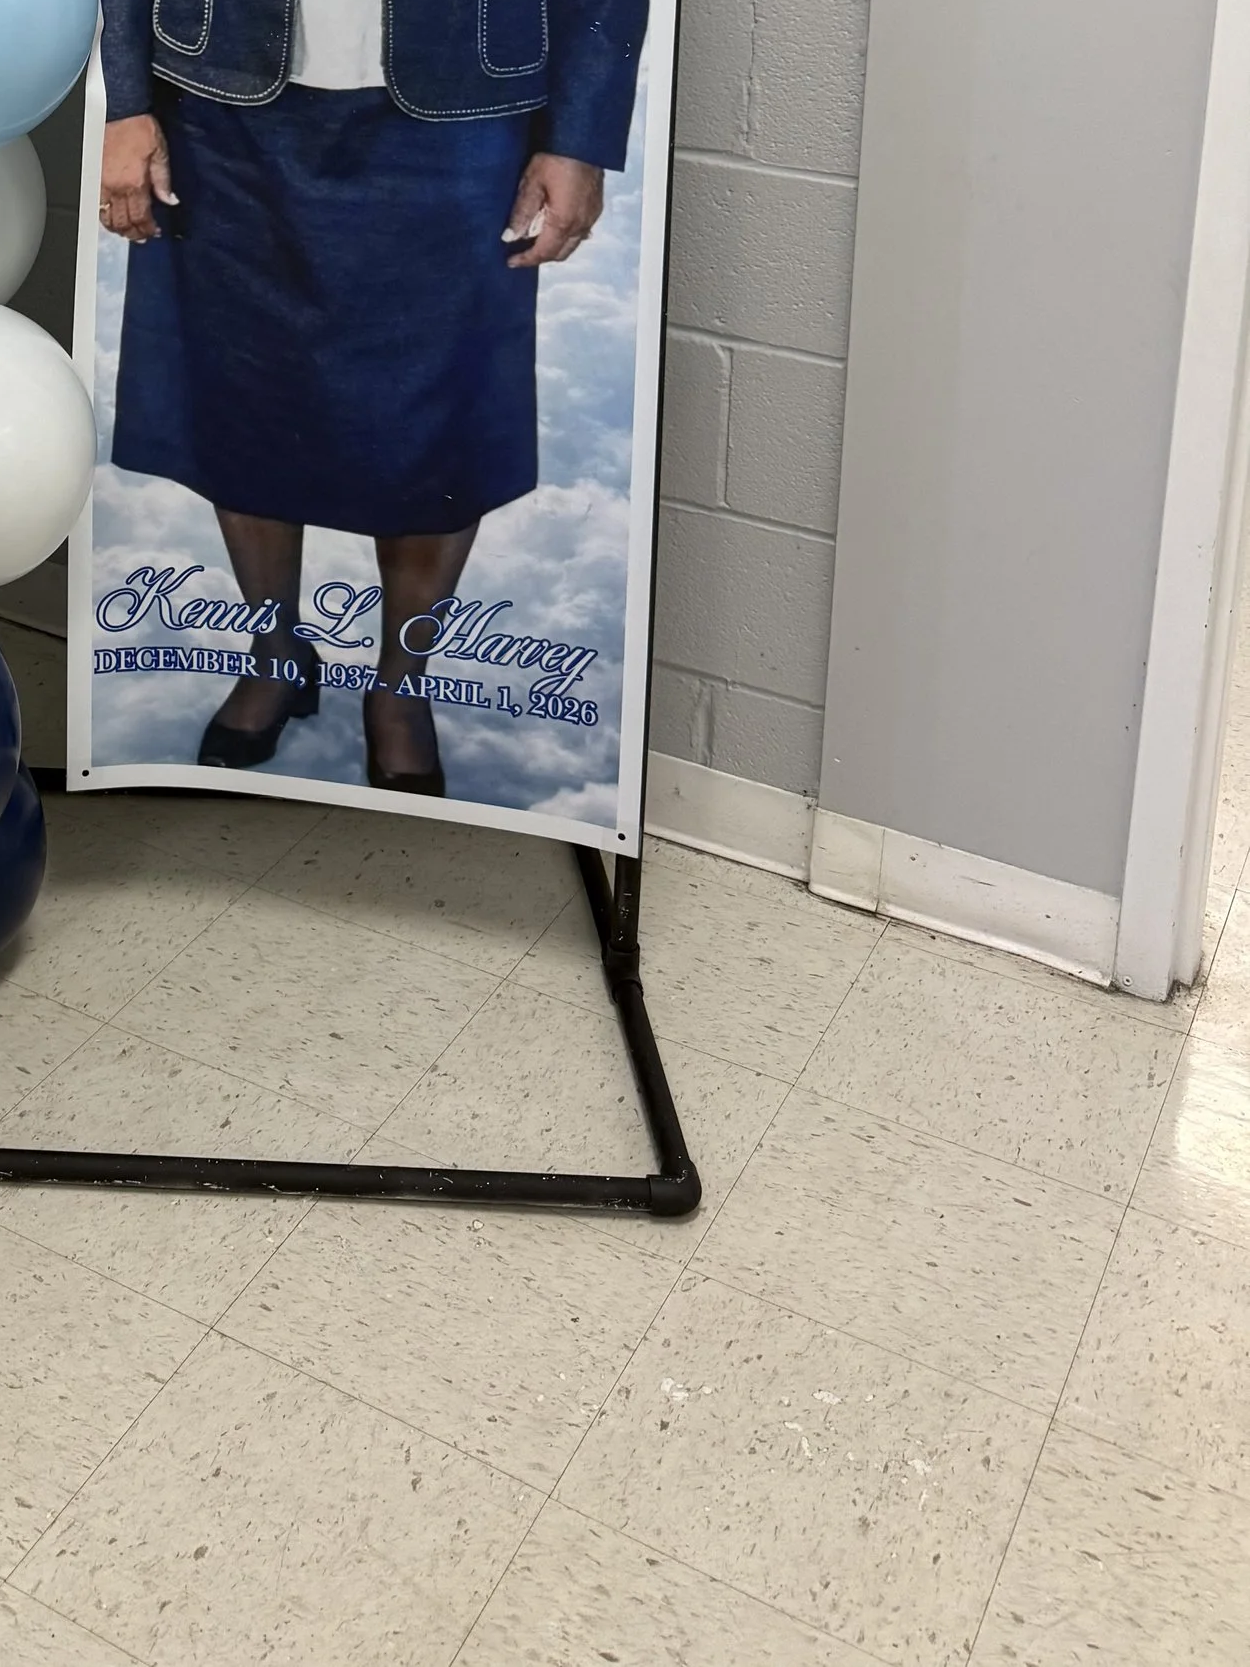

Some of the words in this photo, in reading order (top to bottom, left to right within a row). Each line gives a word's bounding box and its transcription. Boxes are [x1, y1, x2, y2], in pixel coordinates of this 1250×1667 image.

[96, 565, 280, 634] Kennis
[293, 581, 382, 649] L.
[399, 596, 598, 696] Harvey
[94, 646, 260, 678] DECEMBER
[268, 657, 307, 688] 10,
[395, 673, 491, 709] APRIL
[497, 686, 523, 718] 1,
[526, 691, 599, 726] 2026
